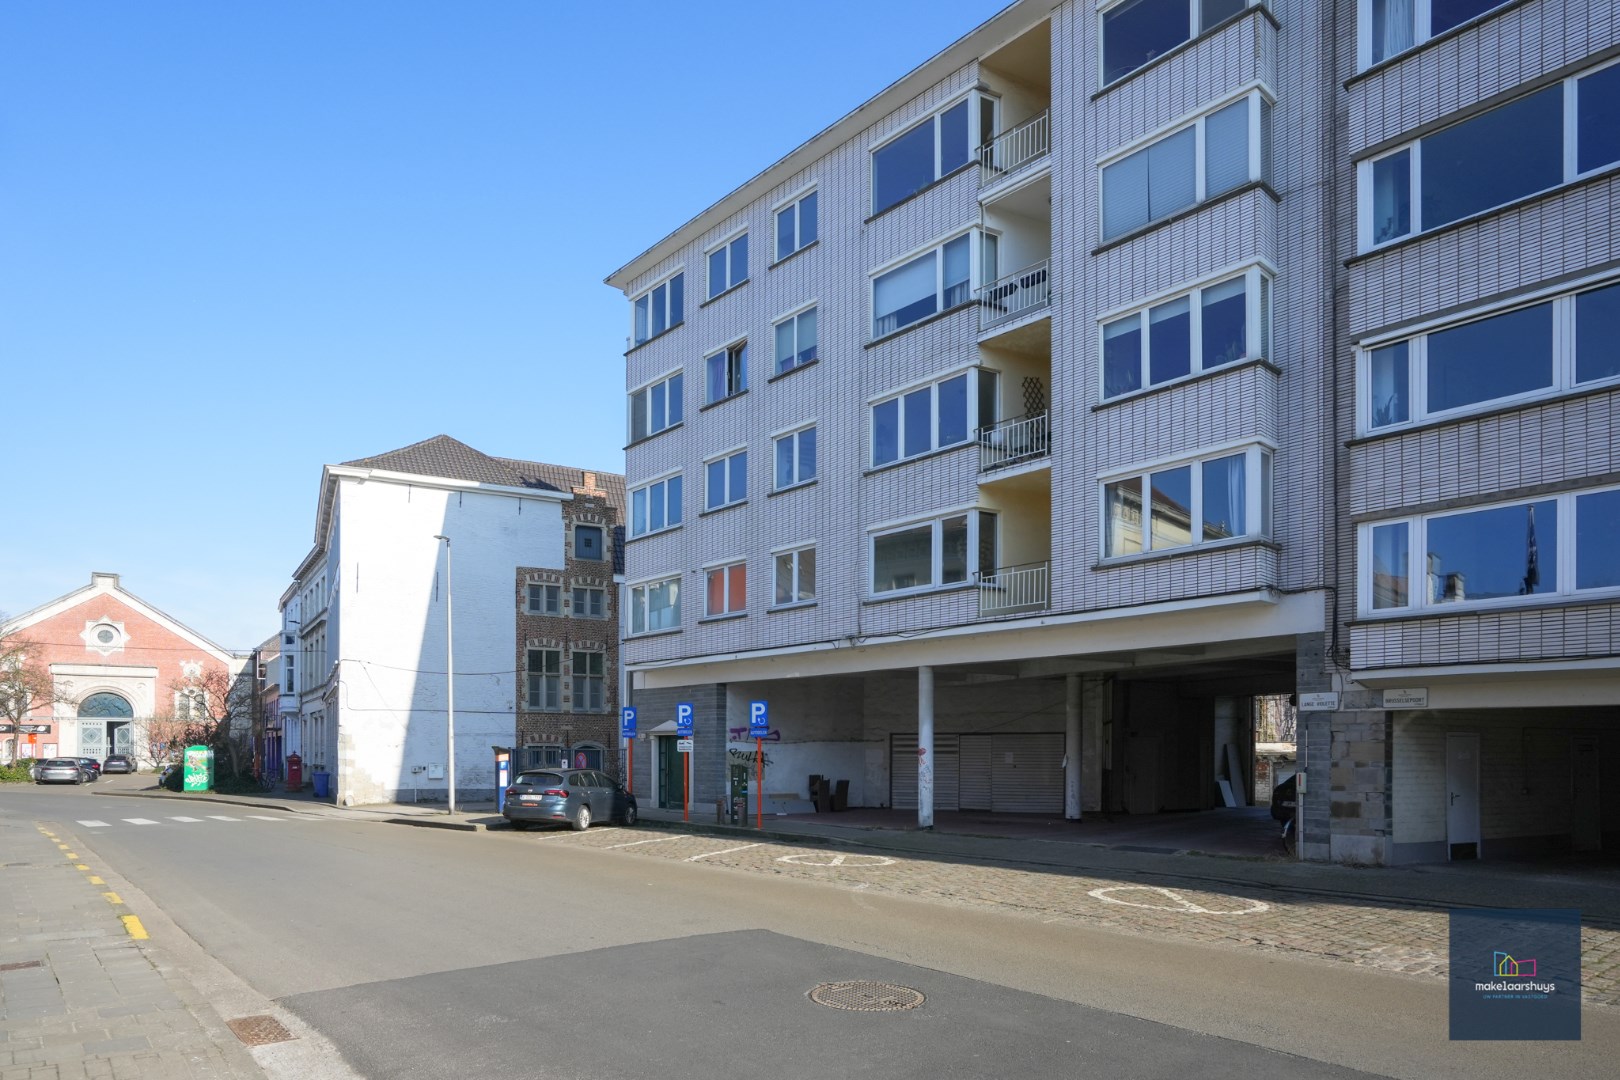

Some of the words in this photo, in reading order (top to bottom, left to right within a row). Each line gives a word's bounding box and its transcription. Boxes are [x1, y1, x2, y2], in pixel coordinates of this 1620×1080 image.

[624, 710, 635, 726] P
[678, 704, 692, 724] P
[751, 702, 766, 723] P
